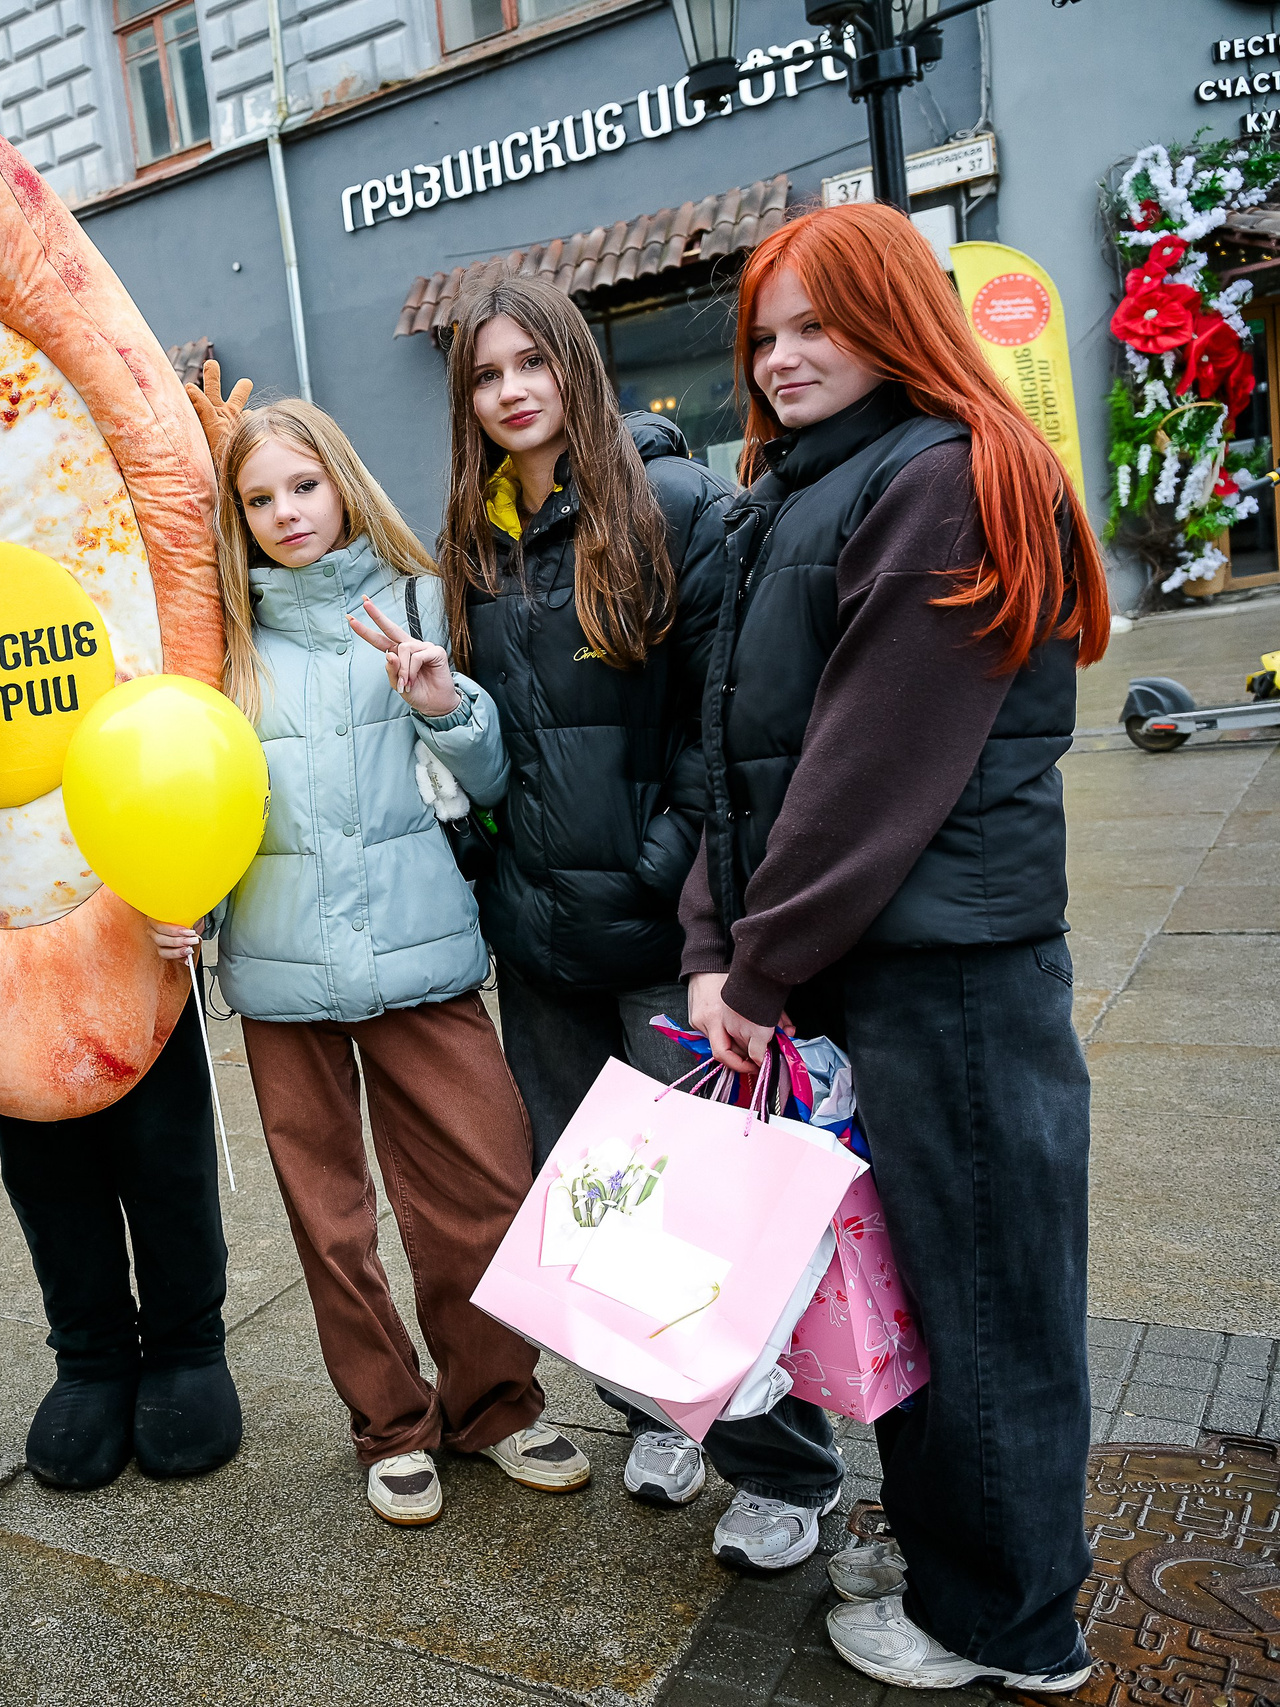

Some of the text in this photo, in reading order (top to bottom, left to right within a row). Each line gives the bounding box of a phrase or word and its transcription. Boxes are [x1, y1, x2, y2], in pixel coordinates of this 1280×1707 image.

[1220, 33, 1280, 61] РЕСТ
[1246, 109, 1280, 133] КУ
[342, 103, 626, 232] ГРУЗИНСКИЕ
[968, 158, 983, 172] 37
[837, 179, 862, 203] 37
